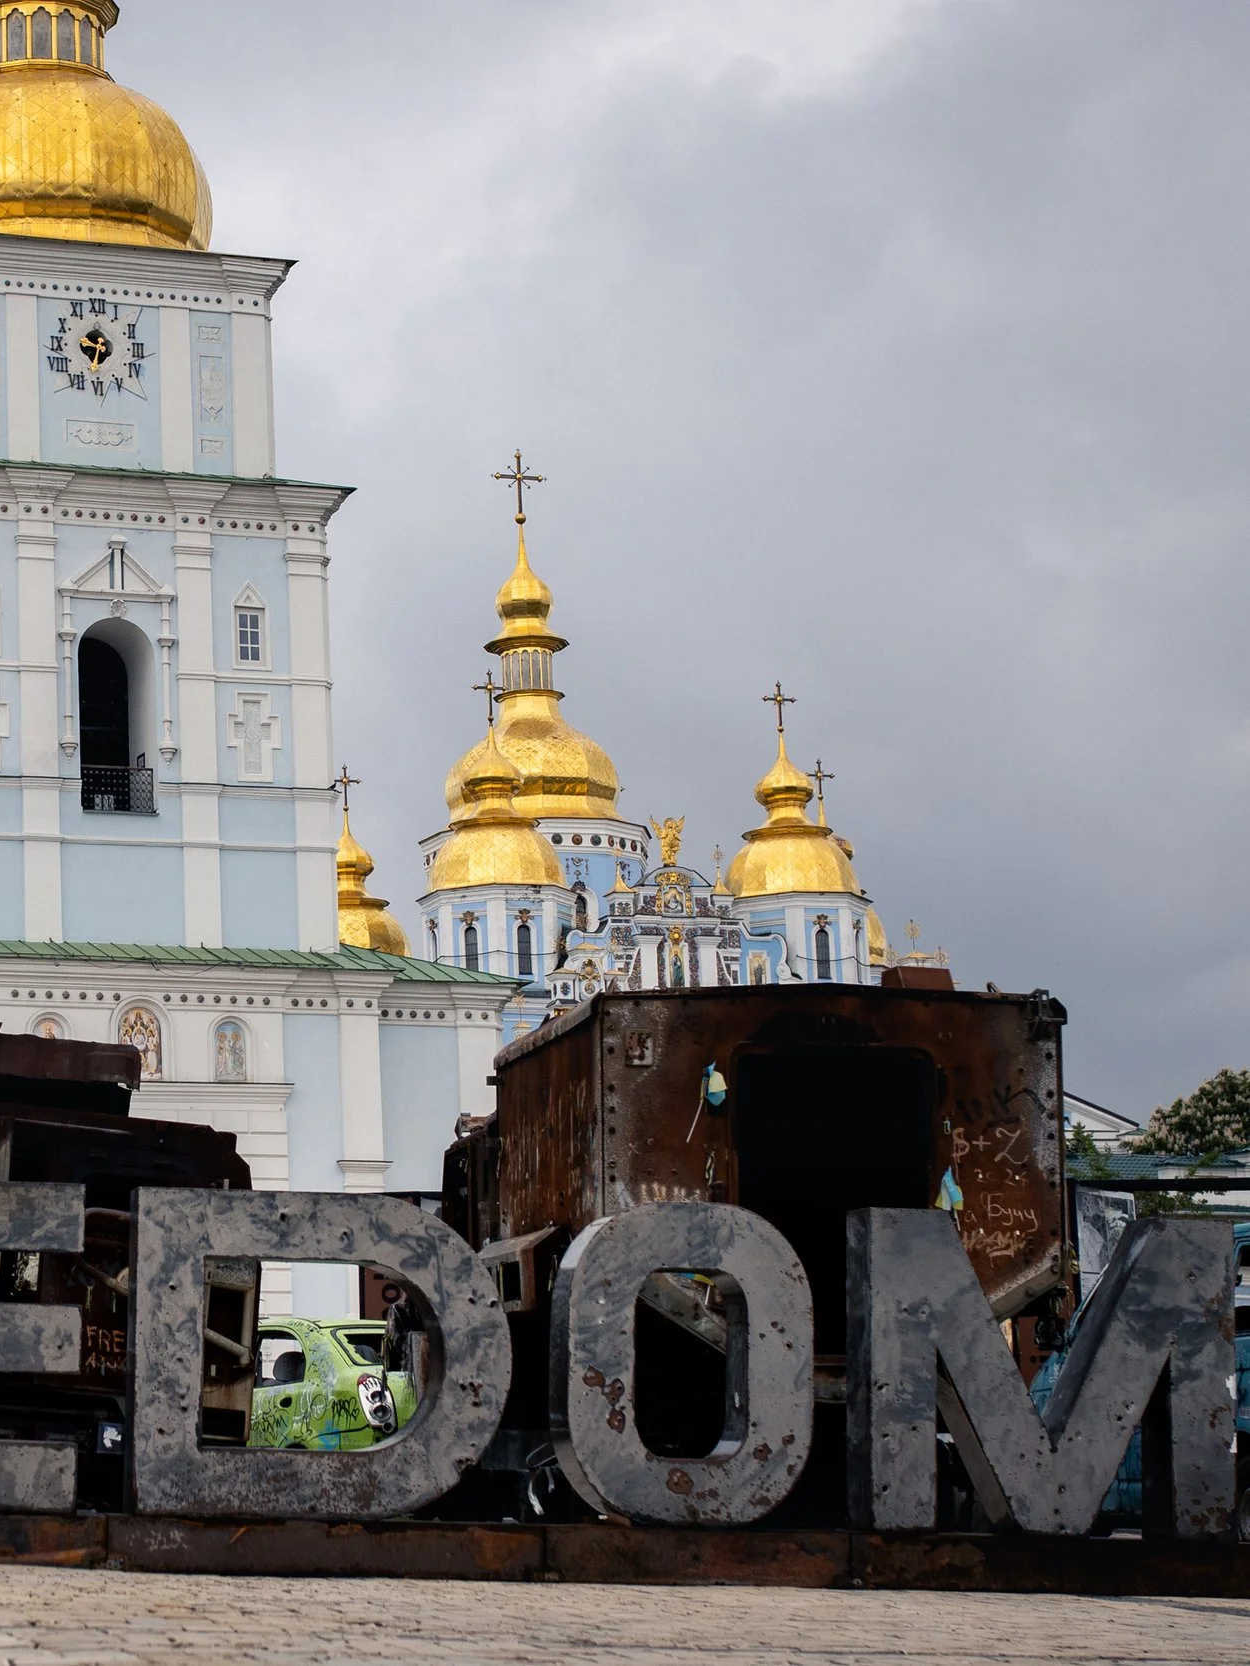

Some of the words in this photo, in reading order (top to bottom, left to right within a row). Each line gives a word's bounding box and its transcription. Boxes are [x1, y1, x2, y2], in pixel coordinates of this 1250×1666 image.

[70, 302, 83, 318] XI
[89, 298, 106, 314] XII
[58, 318, 67, 333] X
[127, 324, 136, 339] II
[50, 336, 64, 352] IX
[132, 343, 145, 358] III
[47, 356, 69, 373] VIII
[128, 363, 141, 378] IV
[68, 373, 85, 391] VII
[91, 380, 104, 396] VI
[114, 378, 123, 393] V
[86, 1325, 127, 1353] FRE
